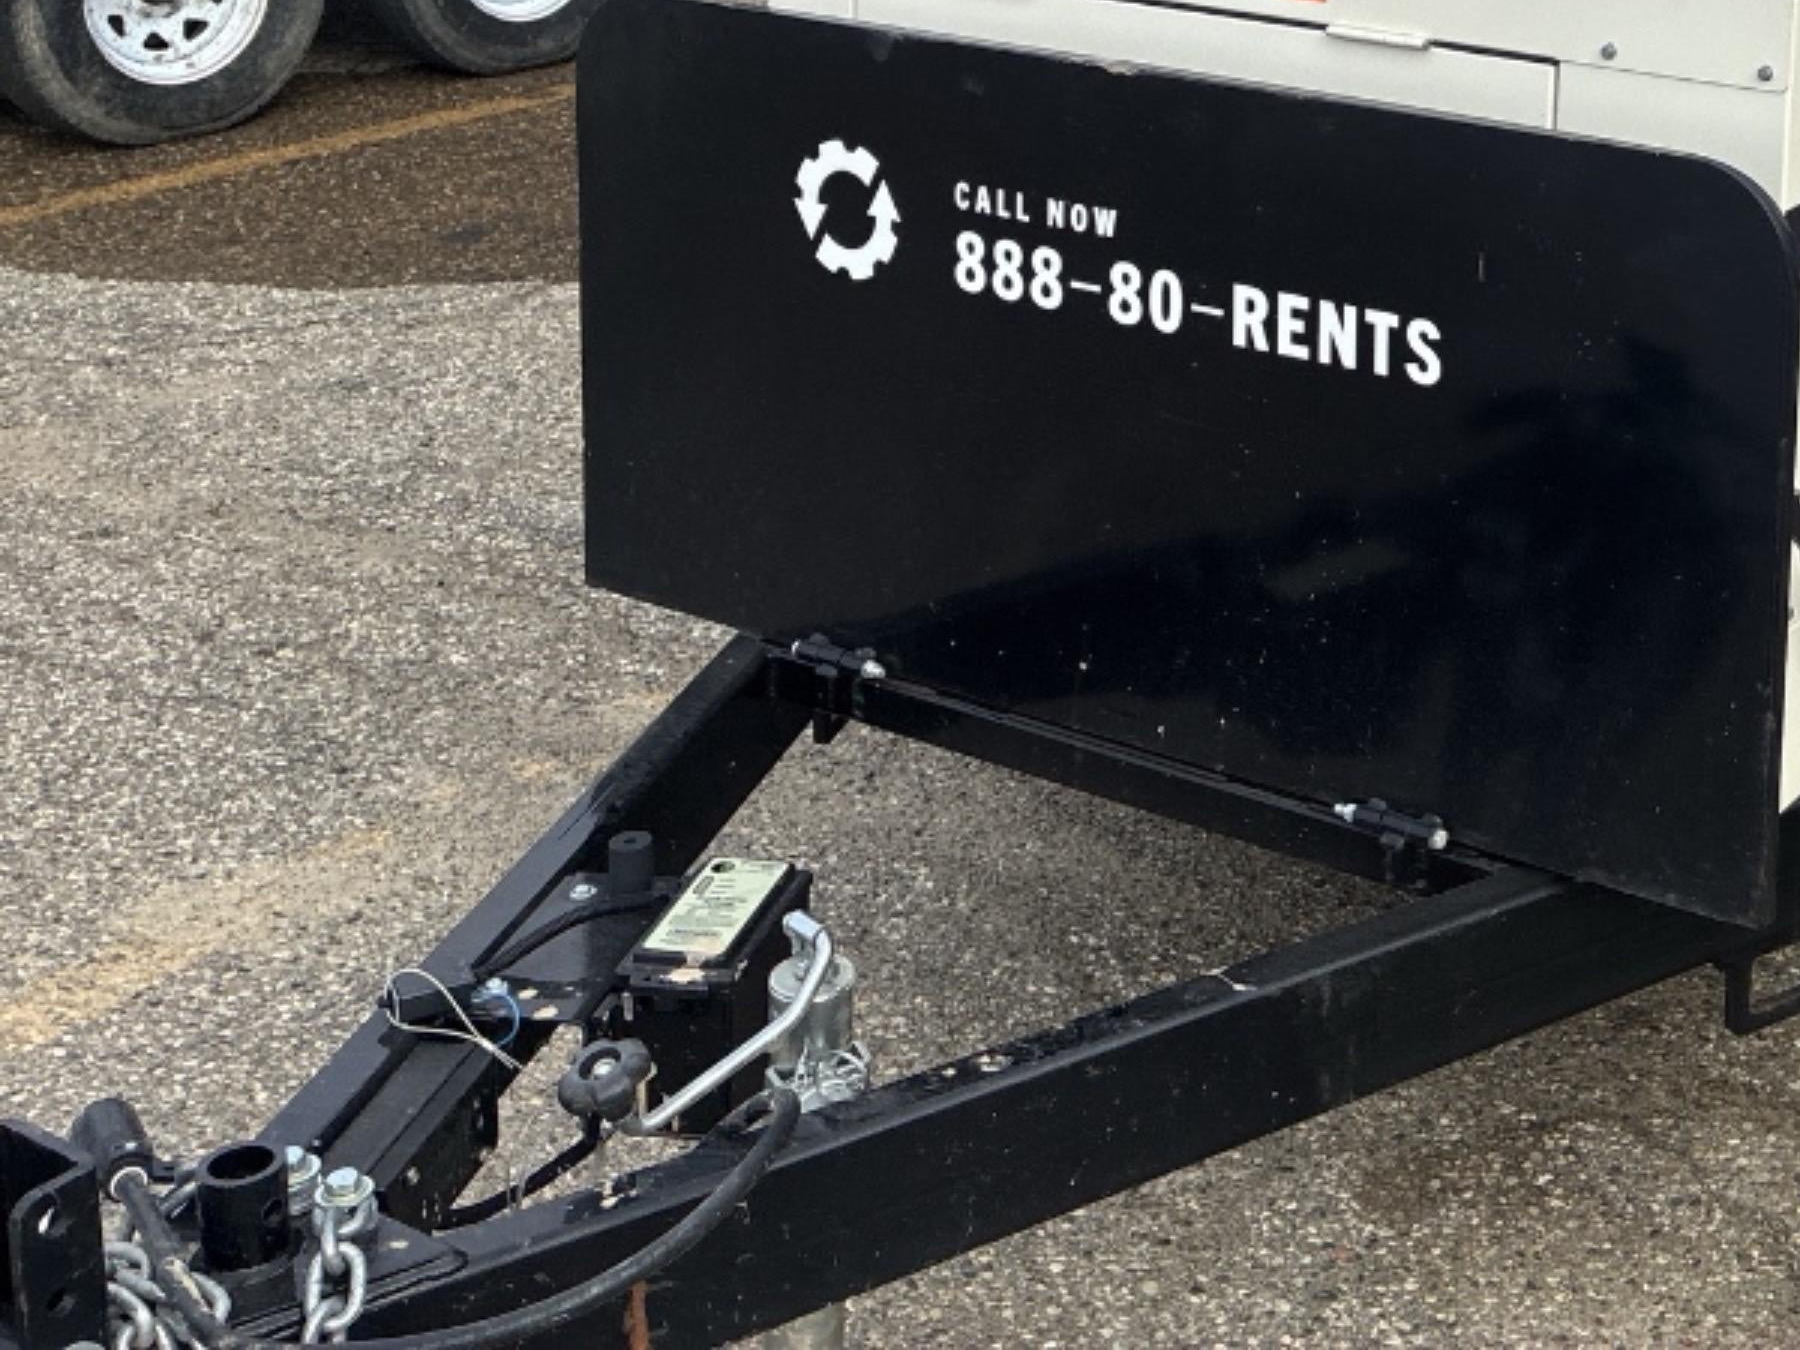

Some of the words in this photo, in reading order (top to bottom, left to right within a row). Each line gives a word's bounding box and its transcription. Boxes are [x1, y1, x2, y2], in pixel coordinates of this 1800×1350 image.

[953, 180, 1031, 223] CALL
[1046, 197, 1119, 238] NOW
[953, 230, 1443, 386] 888-80-RENTS
